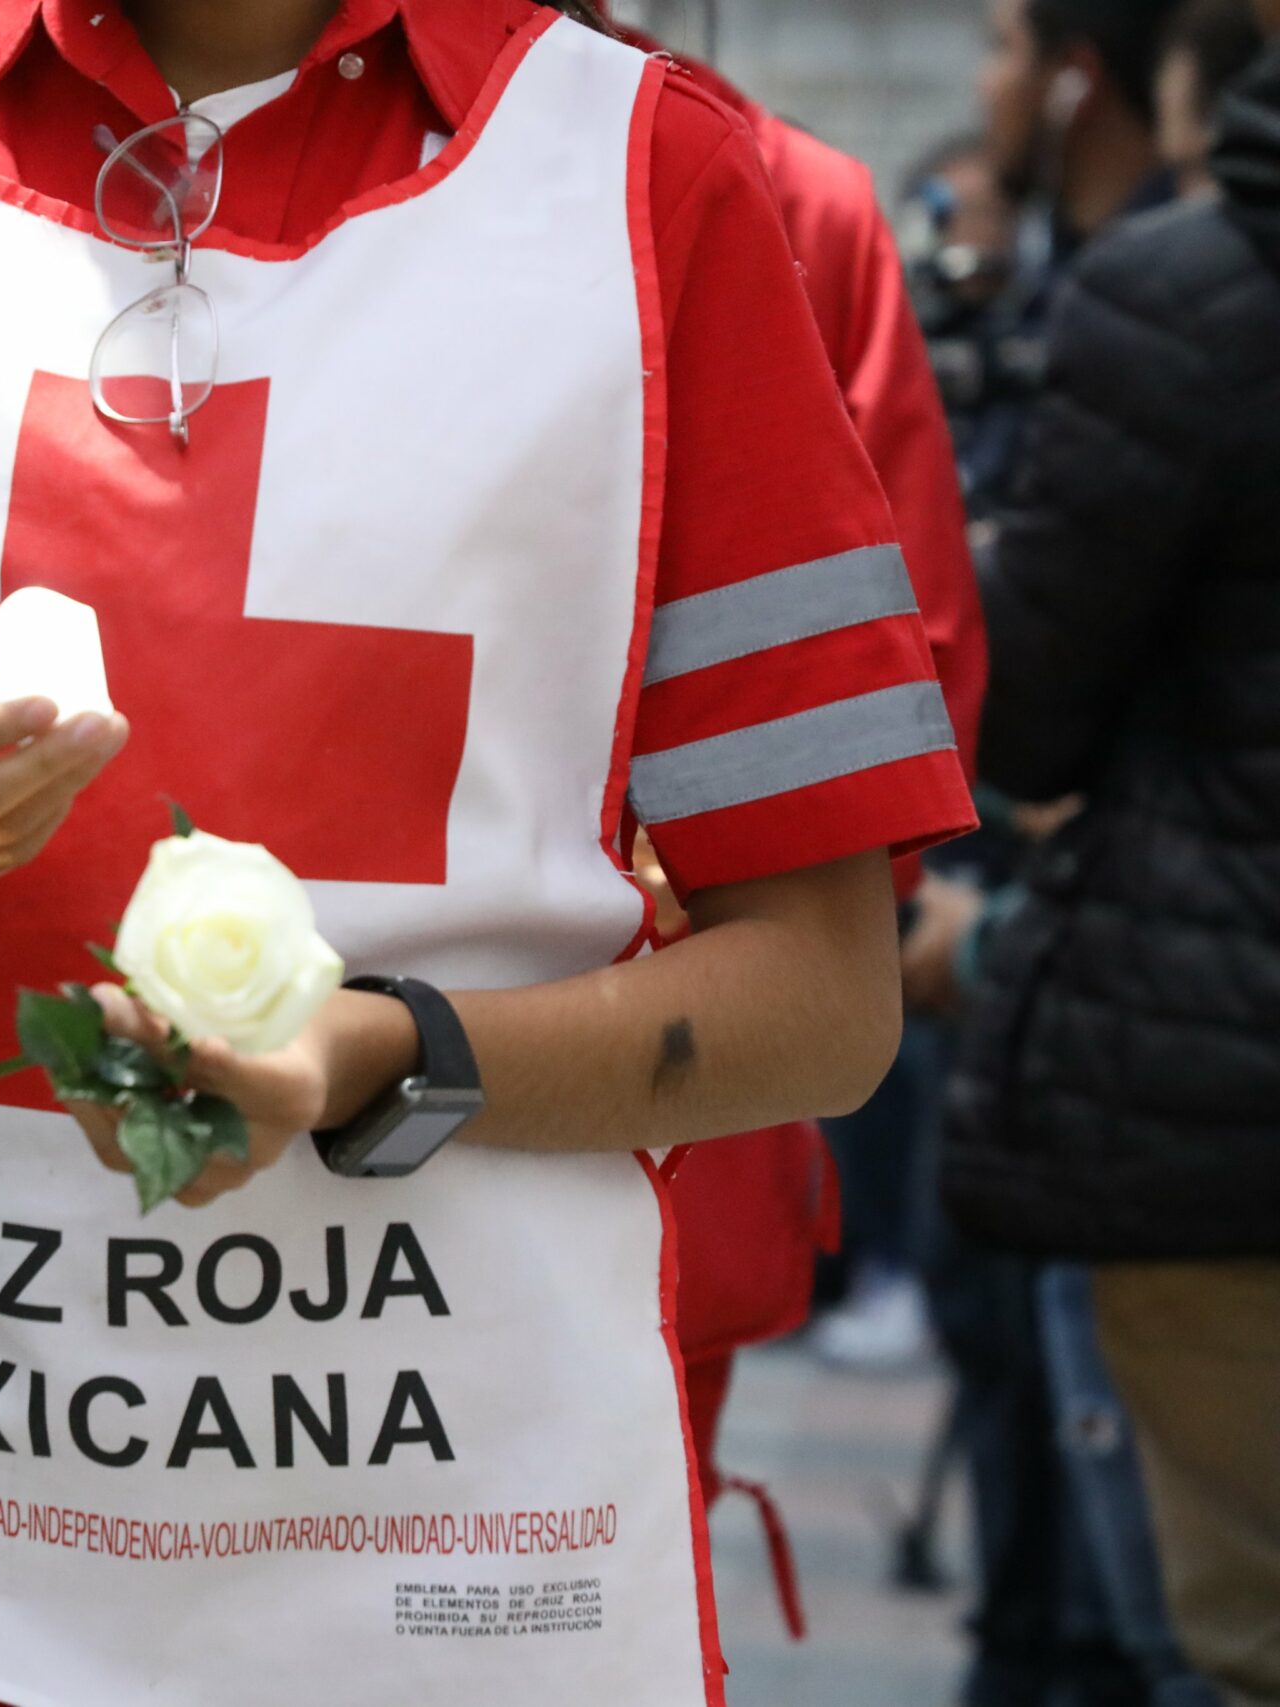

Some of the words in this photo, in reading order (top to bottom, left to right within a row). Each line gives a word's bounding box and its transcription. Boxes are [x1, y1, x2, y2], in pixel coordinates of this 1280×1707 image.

[106, 1222, 451, 1328] ROJA
[395, 1583, 457, 1595] EMBLEMA
[466, 1584, 500, 1596] PARA
[509, 1584, 535, 1596] USO
[542, 1578, 601, 1594] EXCLUSIVO
[395, 1597, 412, 1608] DE
[422, 1597, 500, 1610] ELEMENTOS
[508, 1598, 525, 1609] DE
[533, 1594, 564, 1608] CRUZ
[572, 1591, 602, 1604] ROJA
[395, 1610, 470, 1623] PROHIBIDA
[479, 1612, 497, 1623] SU
[395, 1624, 405, 1636] O
[409, 1625, 449, 1637] VENTA
[451, 1625, 492, 1638] FUERA
[493, 1624, 510, 1637] DE
[512, 1624, 528, 1635] LA
